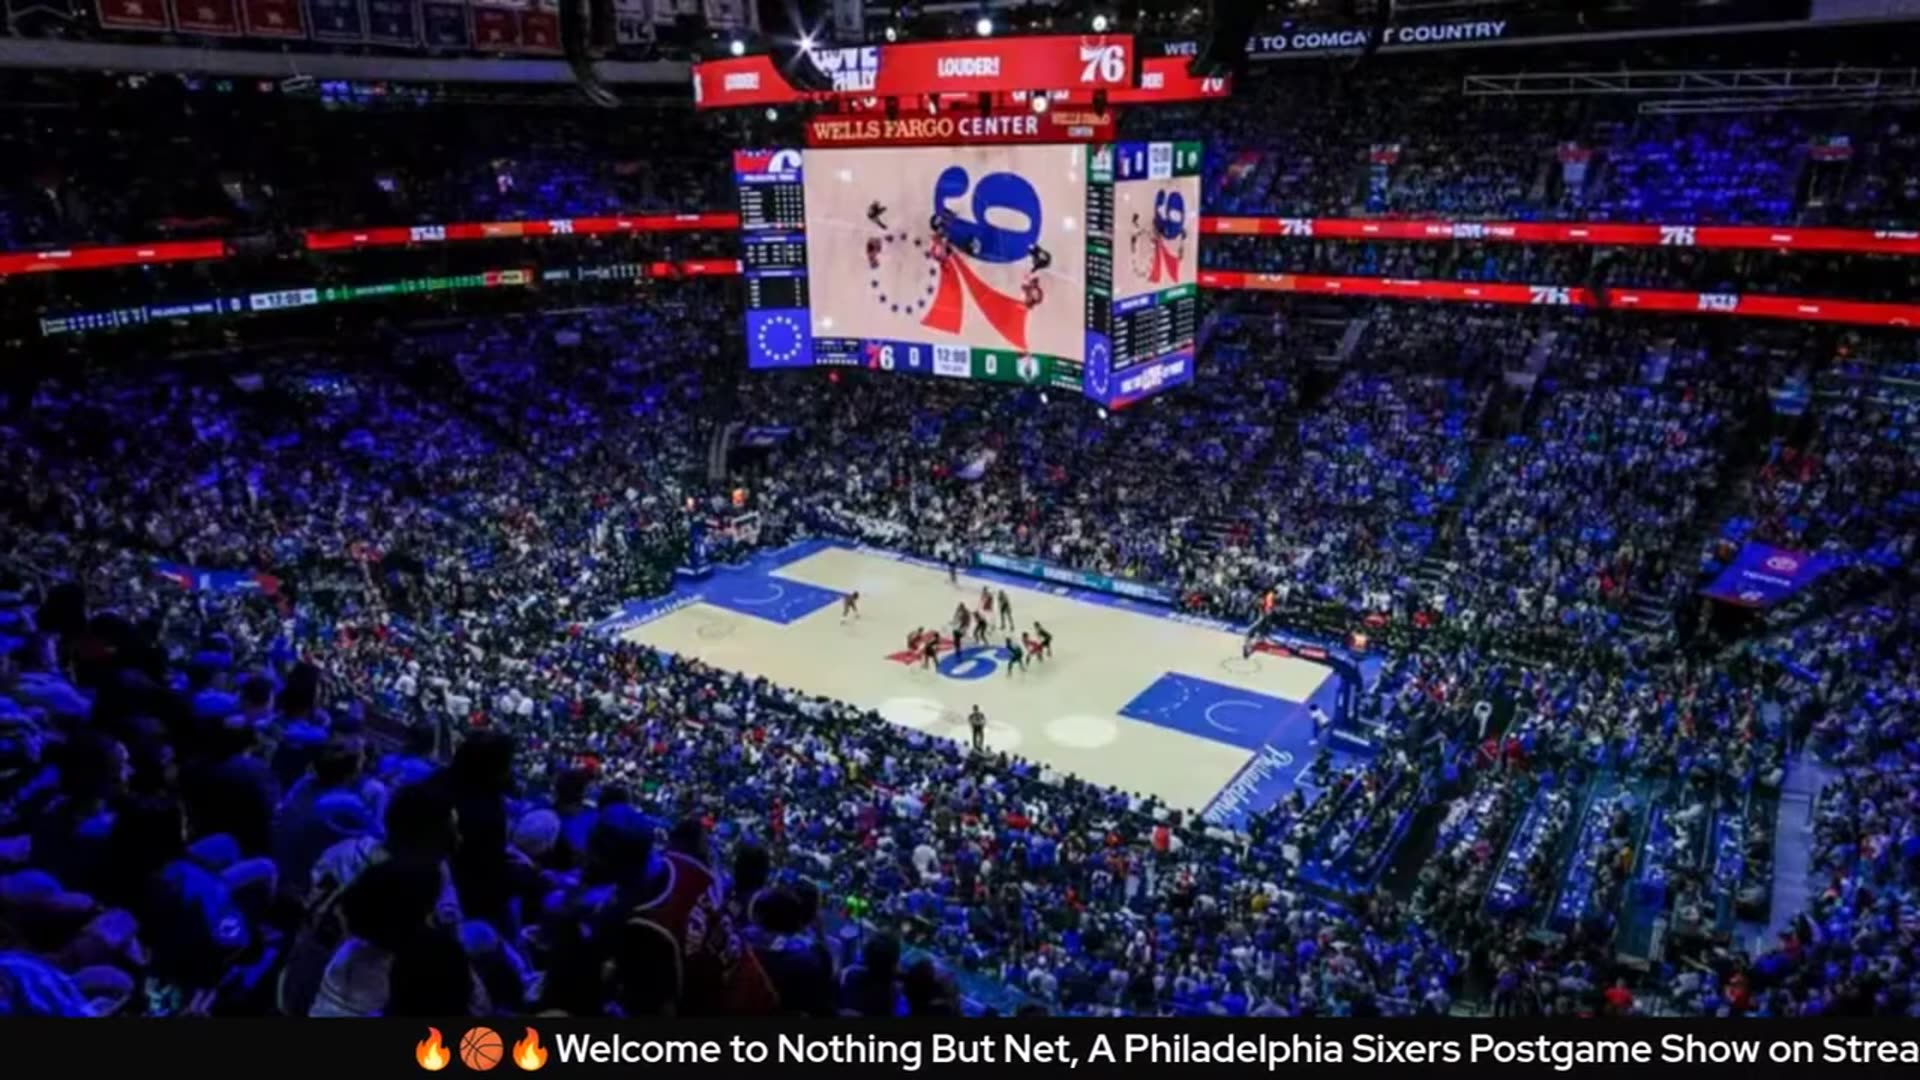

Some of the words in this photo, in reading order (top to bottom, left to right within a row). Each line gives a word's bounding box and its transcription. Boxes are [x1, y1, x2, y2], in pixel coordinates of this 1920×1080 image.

[1261, 37, 1287, 51] TO
[1292, 29, 1394, 49] COMCAT
[1400, 21, 1506, 42] COUNTRY
[937, 56, 1000, 78] LOUDER!
[1080, 44, 1125, 83] 76
[813, 119, 881, 141] WELLS
[882, 116, 954, 138] FARGO
[957, 115, 1039, 136] CENTER
[866, 343, 895, 371] 76
[909, 346, 920, 367] 0
[985, 353, 998, 375] 0
